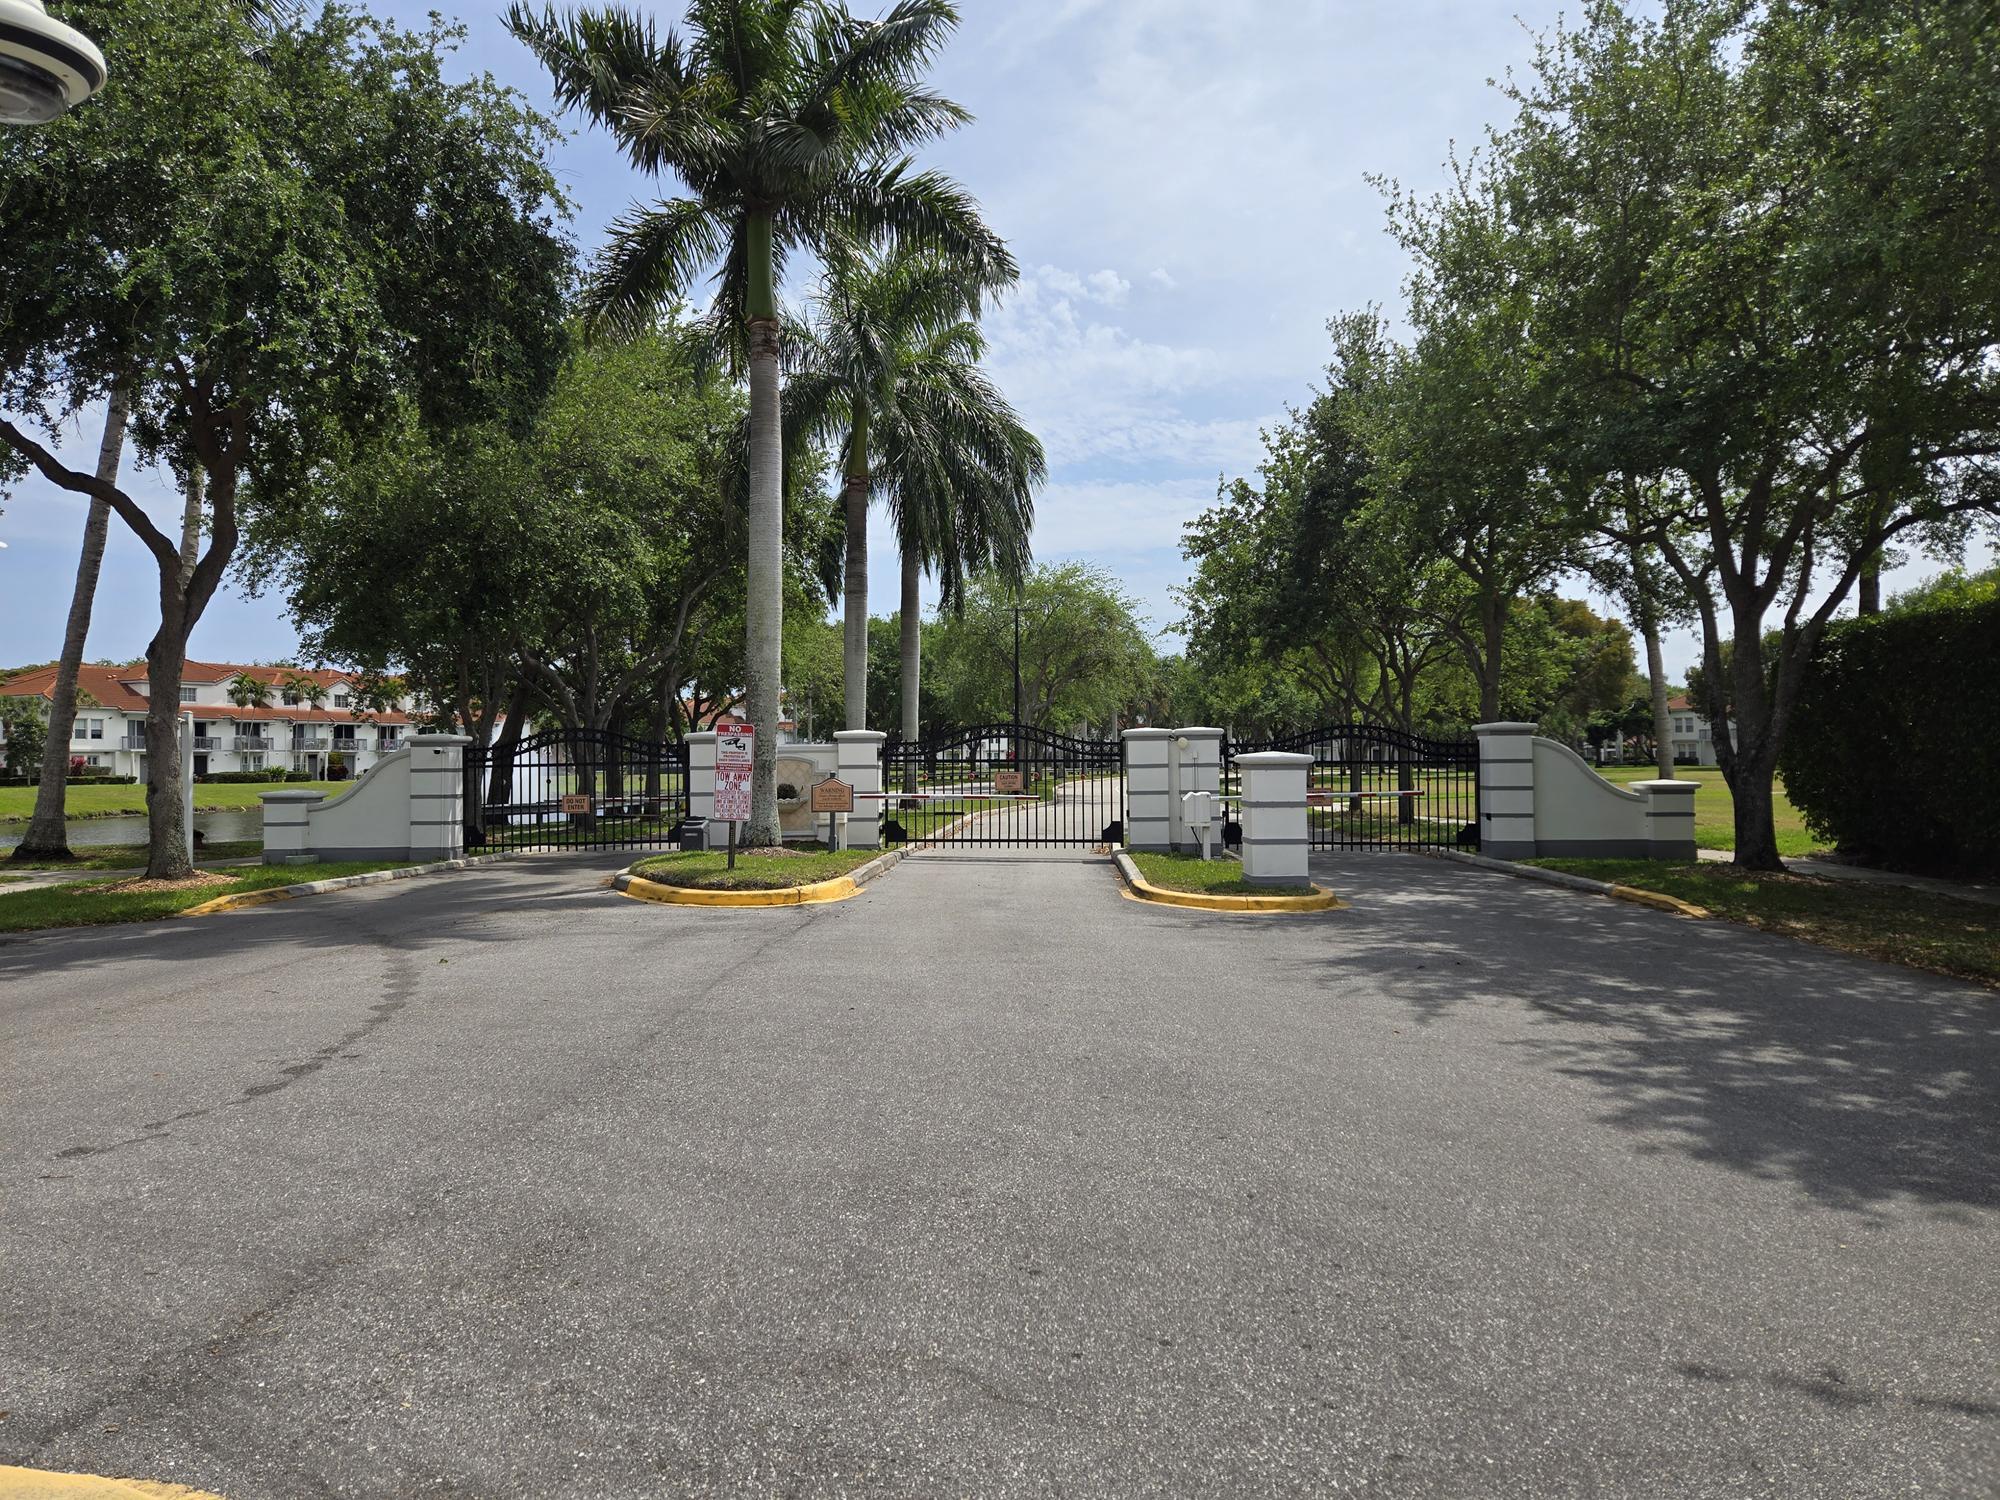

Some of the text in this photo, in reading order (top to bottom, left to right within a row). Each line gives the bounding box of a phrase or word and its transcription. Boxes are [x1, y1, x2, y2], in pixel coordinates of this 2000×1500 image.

[718, 772, 750, 782] TOW AWAY
[724, 780, 742, 790] ZONE
